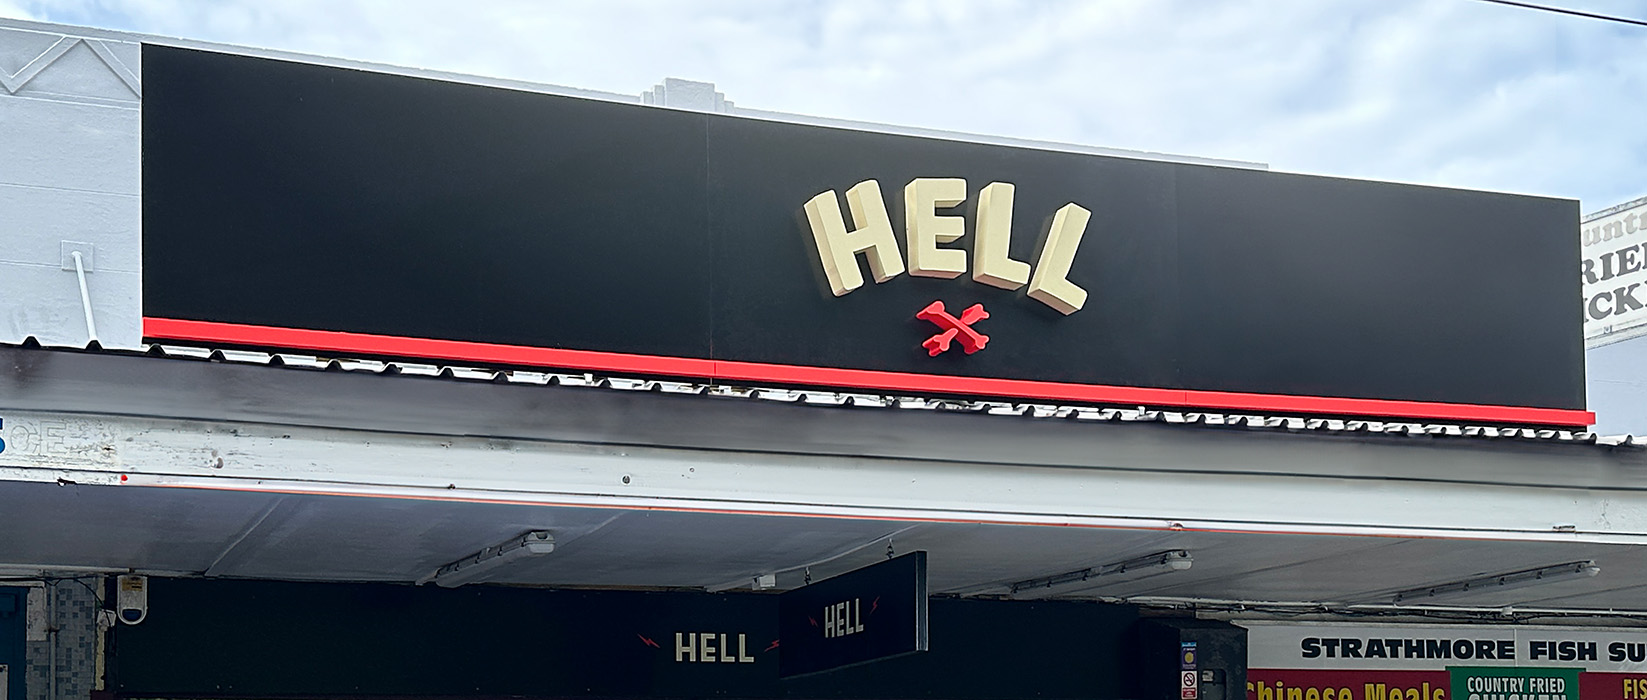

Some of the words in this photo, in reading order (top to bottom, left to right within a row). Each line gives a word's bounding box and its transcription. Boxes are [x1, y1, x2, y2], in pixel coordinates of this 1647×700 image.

[803, 177, 1092, 316] HELL
[1582, 242, 1647, 285] RIE
[1583, 280, 1647, 323] CK
[824, 598, 864, 638] HELL
[675, 632, 755, 662] HELL
[1301, 637, 1516, 660] STRATHMORE
[1529, 640, 1598, 661] FISH
[1608, 641, 1647, 663] SU
[1467, 676, 1525, 693] COUNTRY
[1529, 677, 1565, 693] FRIED
